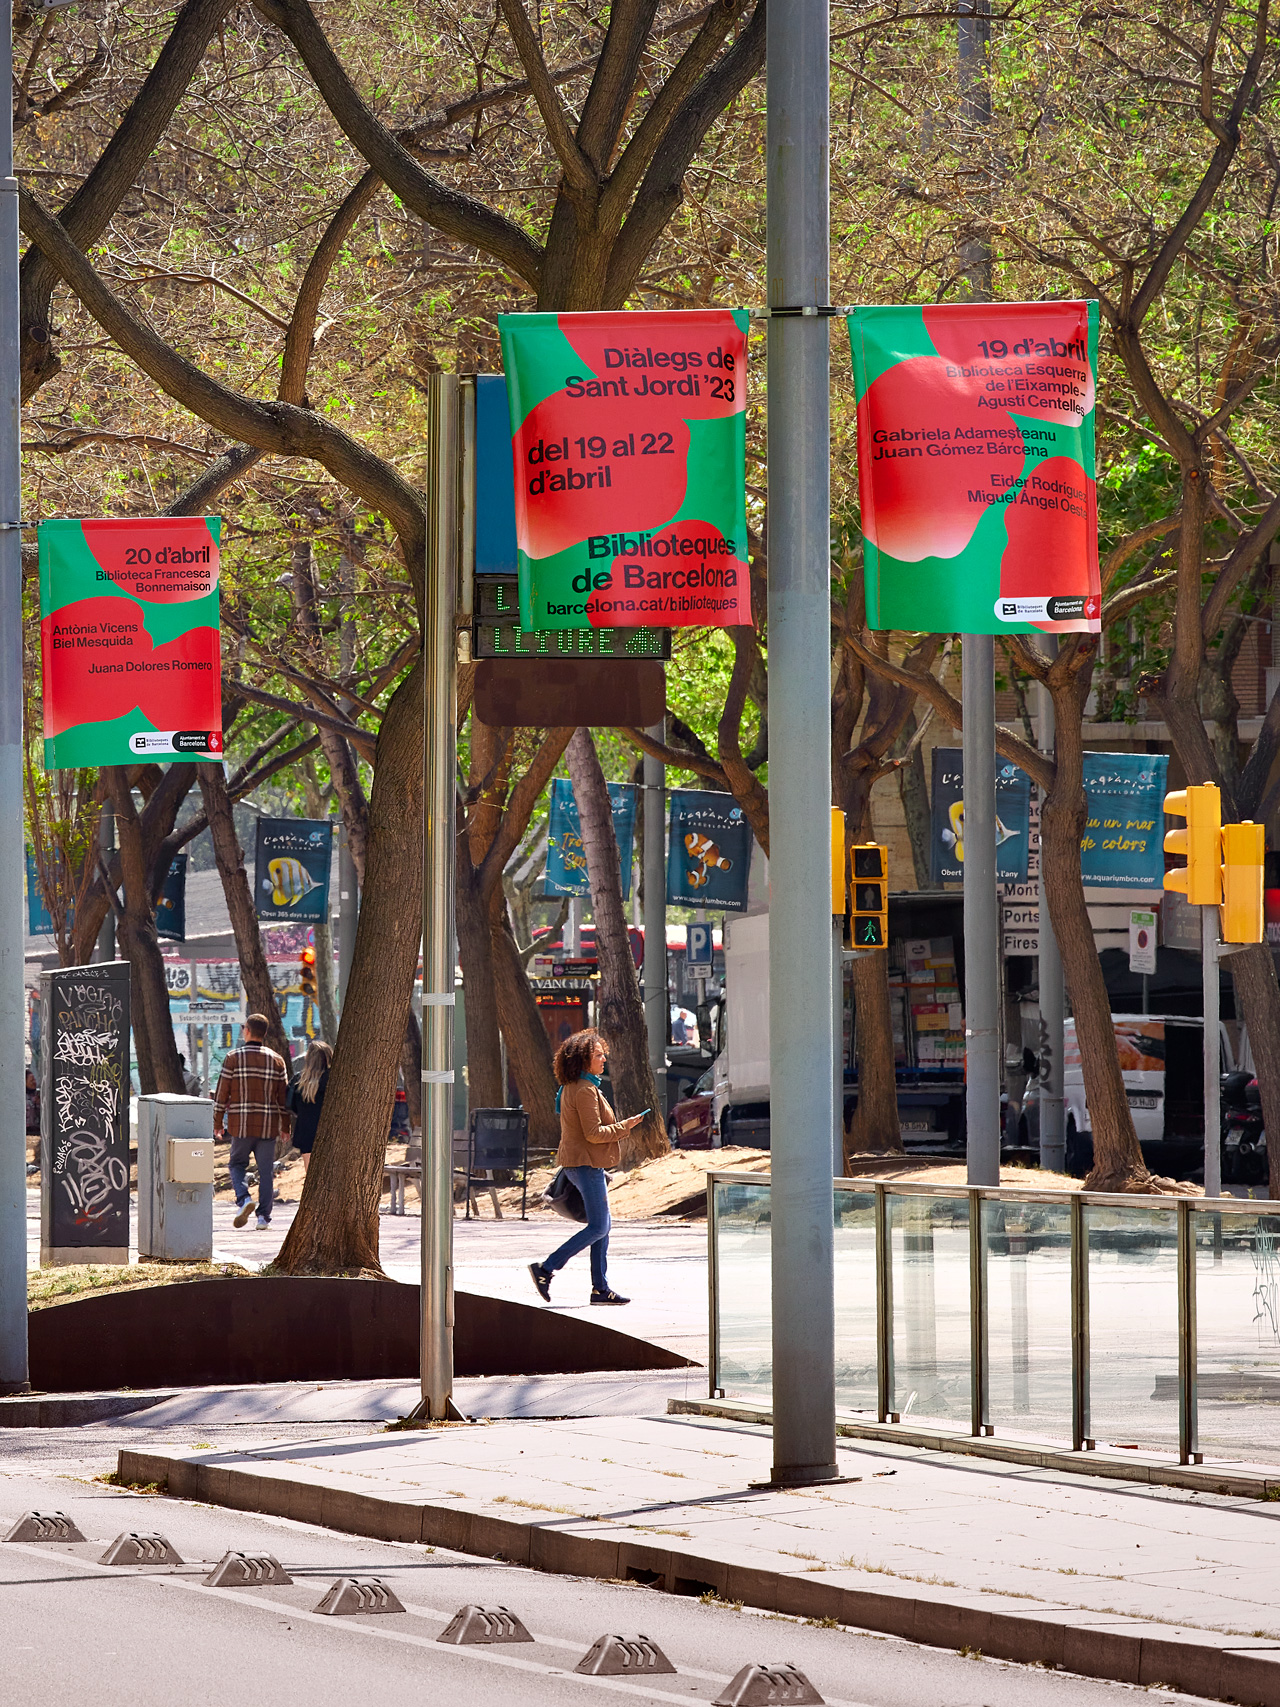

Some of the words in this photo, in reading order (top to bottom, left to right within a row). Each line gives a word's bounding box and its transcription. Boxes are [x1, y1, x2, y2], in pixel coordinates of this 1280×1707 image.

[978, 340, 1009, 359] 19
[604, 348, 703, 372] Diàlegs
[707, 347, 735, 372] de
[946, 365, 1023, 378] Biblioteca
[1026, 364, 1086, 382] Esquerra
[565, 376, 630, 398] Sant
[634, 374, 701, 397] Jordi
[986, 380, 1005, 393] de
[977, 395, 1025, 410] Agustí
[1028, 395, 1085, 416] Centelles
[873, 428, 950, 443] Gabriela
[528, 438, 569, 465] del
[574, 436, 607, 459] 19
[612, 433, 636, 458] al
[640, 432, 675, 455] 22
[873, 445, 923, 461] Juan
[926, 442, 984, 456] Gómez
[987, 443, 1048, 457] Bárcena
[990, 474, 1029, 490] Eider
[1032, 476, 1087, 502] Rodríguez
[968, 490, 1018, 505] Miguel
[1020, 488, 1058, 510] Ángel
[1061, 500, 1087, 520] Oeste
[588, 534, 736, 559] Biblioteques
[125, 548, 152, 565] 20
[96, 571, 153, 580] Biblioteca
[155, 570, 211, 579] Francesca
[572, 568, 613, 594] de
[623, 563, 737, 589] Barcelona
[136, 582, 211, 592] Bonnemaison
[547, 596, 738, 615] barcelona.cat/biblioteques
[1054, 606, 1083, 614] Barcelona
[53, 623, 97, 635] Antònia
[99, 623, 138, 633] Vicens
[53, 638, 75, 648] Biel
[76, 636, 133, 648] Mesquida
[88, 663, 124, 674] Juana
[126, 661, 170, 672] Dolores
[172, 660, 212, 671] Romero
[1086, 817, 1101, 828] iu
[1081, 838, 1096, 852] de
[1102, 835, 1146, 853] colors
[690, 927, 707, 960] P
[1005, 936, 1038, 949] Fires
